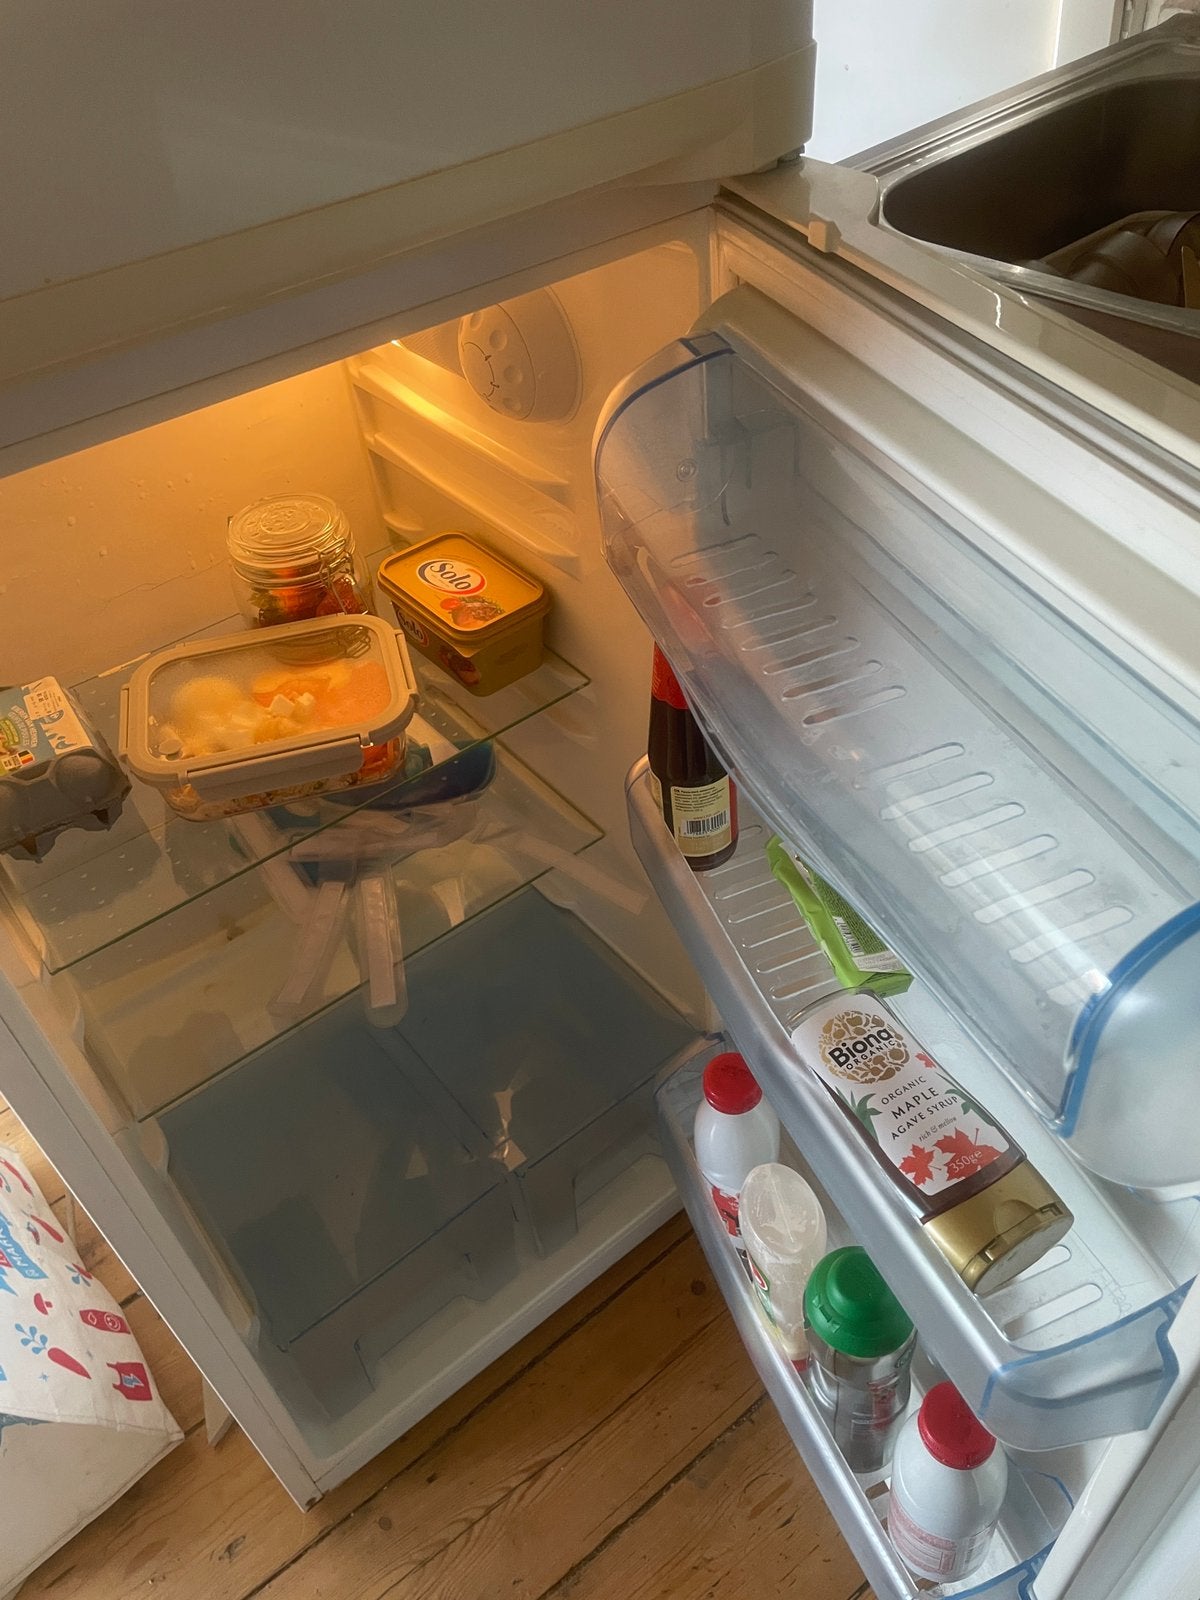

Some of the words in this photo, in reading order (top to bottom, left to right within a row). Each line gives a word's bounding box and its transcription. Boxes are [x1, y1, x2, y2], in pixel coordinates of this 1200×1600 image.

[430, 563, 472, 590] Solo
[828, 1028, 894, 1068] Biona
[846, 1040, 896, 1070] ORGANIC
[881, 1076, 927, 1105] ORGANIC
[891, 1087, 939, 1120] MAPLE
[891, 1112, 926, 1140] AGAVE
[926, 1096, 958, 1115] SYRUP
[919, 1130, 931, 1142] rich
